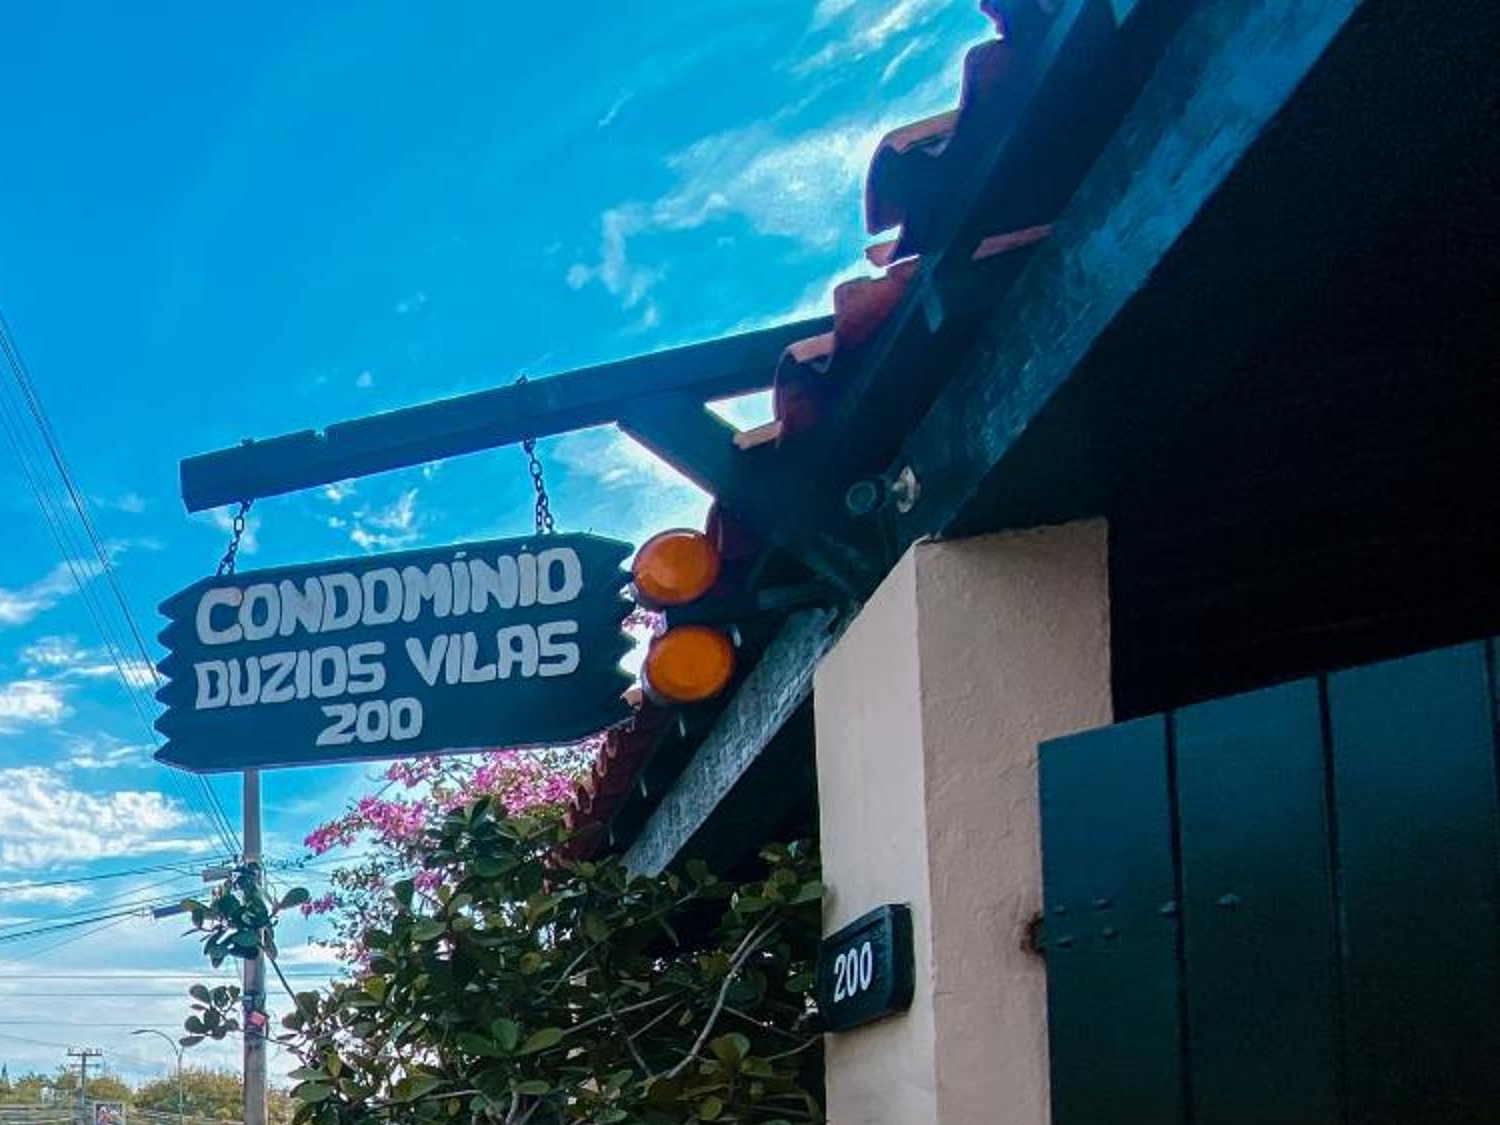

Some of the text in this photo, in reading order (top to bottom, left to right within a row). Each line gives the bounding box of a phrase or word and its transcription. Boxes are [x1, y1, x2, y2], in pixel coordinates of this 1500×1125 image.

[406, 620, 580, 687] VILAS
[316, 698, 423, 746] 200
[833, 941, 873, 1003] 200
